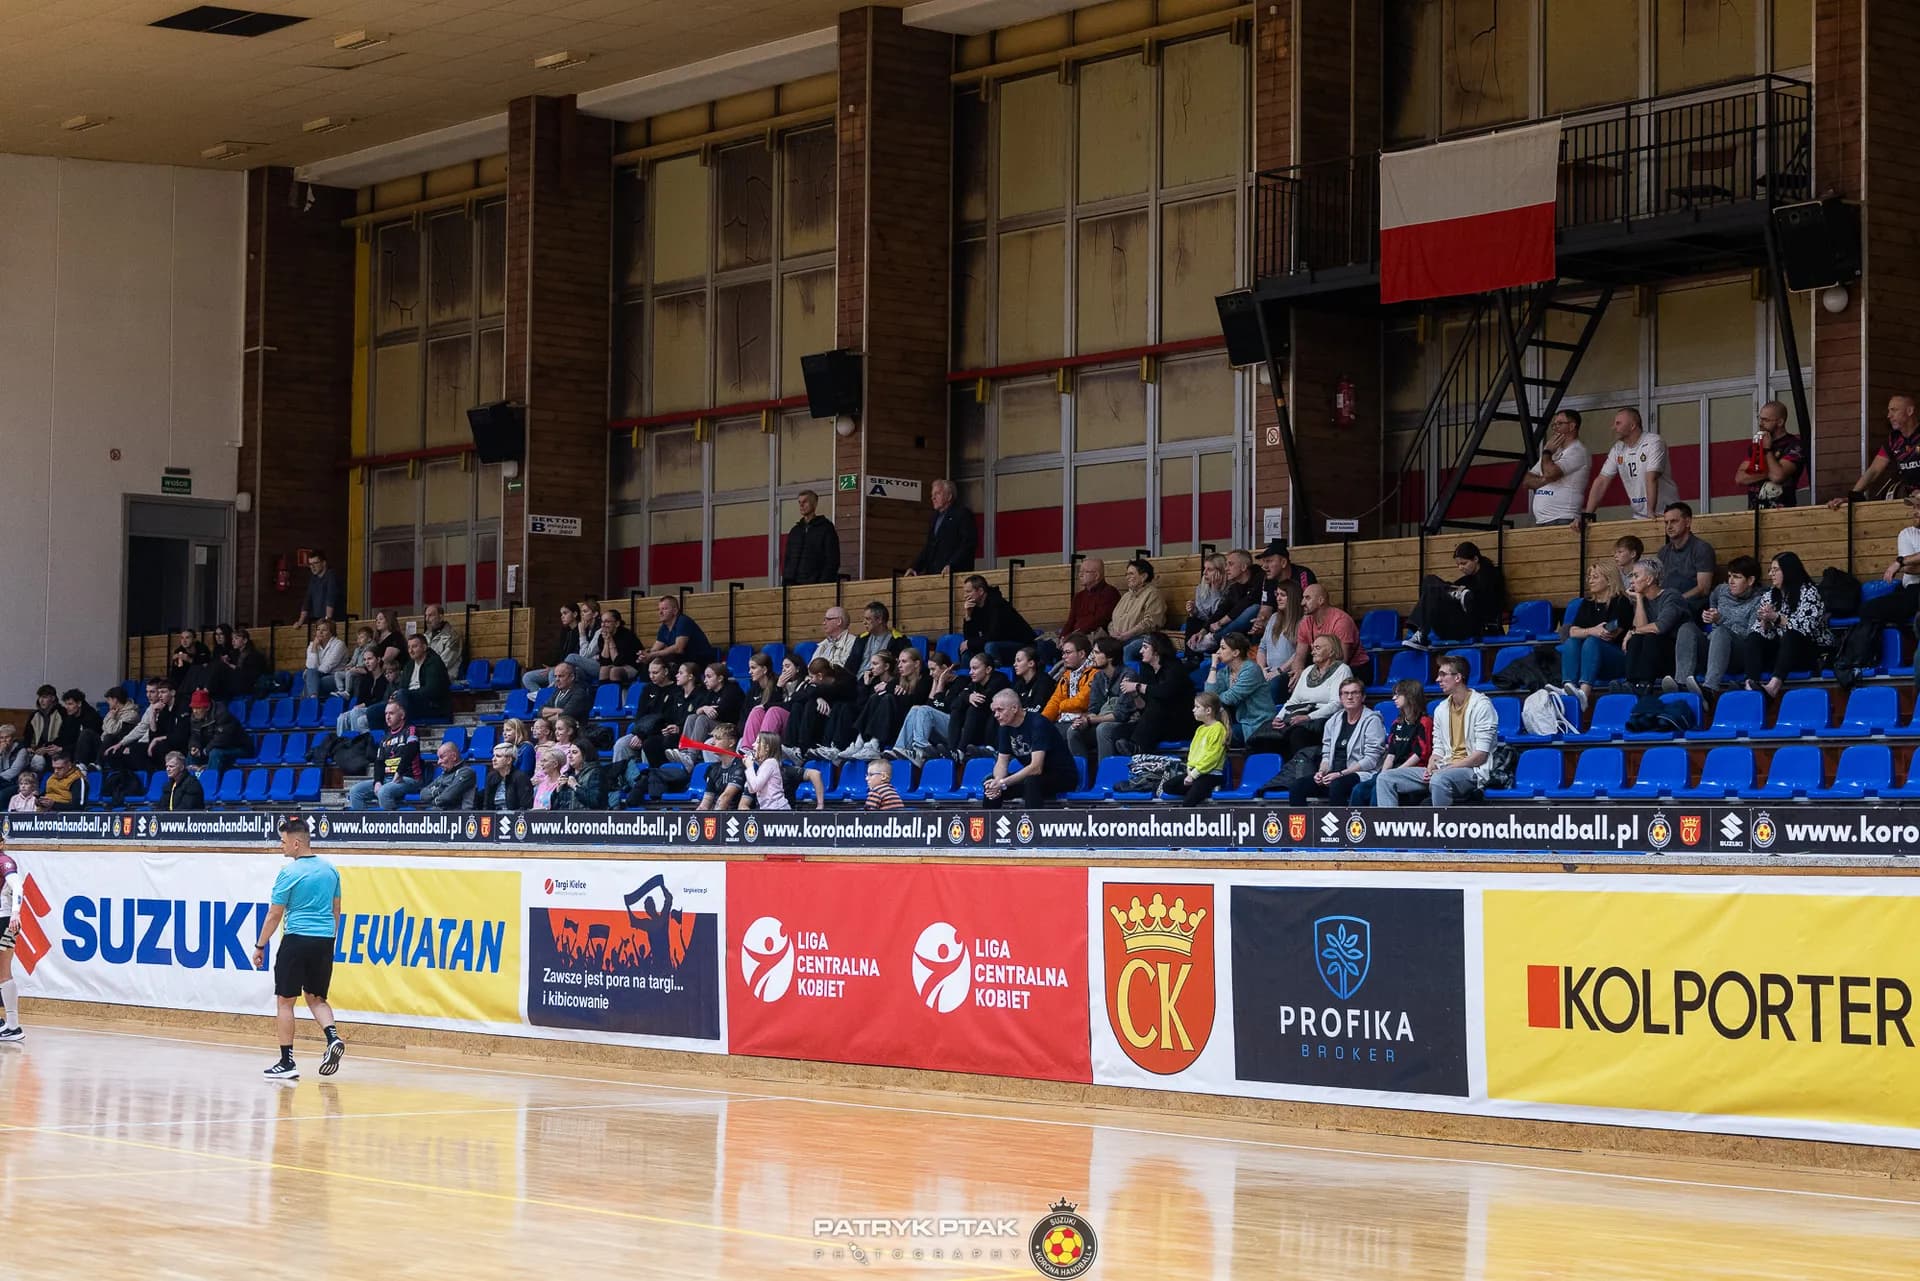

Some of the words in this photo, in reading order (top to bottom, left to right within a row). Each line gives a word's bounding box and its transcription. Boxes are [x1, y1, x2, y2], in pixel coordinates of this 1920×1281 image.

[1628, 462, 1638, 478] 12
[869, 484, 887, 497] A
[870, 477, 918, 488] SEKTOR
[531, 516, 577, 525] SEKTOR
[531, 522, 546, 532] B
[12, 815, 111, 837] www.koronahandball.pl
[160, 815, 274, 838] www.koronahandball.pl
[332, 815, 462, 840] www.koronahandball.pl
[531, 816, 682, 842] www.koronahandball.pl
[763, 816, 942, 845] www.koronahandball.pl
[1039, 813, 1255, 845] www.koronahandball.pl
[1373, 813, 1639, 848] www.koronahandball.pl
[1683, 827, 1697, 842] CK
[1785, 814, 1920, 843] www.koro
[555, 879, 569, 891] Targi
[570, 879, 587, 889] Kielce
[62, 895, 270, 972] SUZUKI
[333, 907, 506, 974] LEWIATAN
[797, 931, 829, 951] LIGA
[975, 938, 1011, 959] LIGA
[797, 955, 880, 977] CENTRALNA
[974, 963, 1069, 988] CENTRALNA
[543, 967, 582, 985] Zawsze
[584, 970, 604, 988] jest
[606, 974, 630, 990] pora
[633, 976, 646, 988] na
[648, 974, 684, 994] targi...
[797, 978, 846, 998] KOBIET
[542, 990, 547, 1005] i
[548, 991, 609, 1009] kibicowanie
[975, 988, 1031, 1010] KOBIET
[1116, 957, 1196, 1052] CK
[1564, 965, 1916, 1048] KOLPORTER
[1279, 1005, 1415, 1042] PROFIKA
[1301, 1044, 1395, 1062] BROKER
